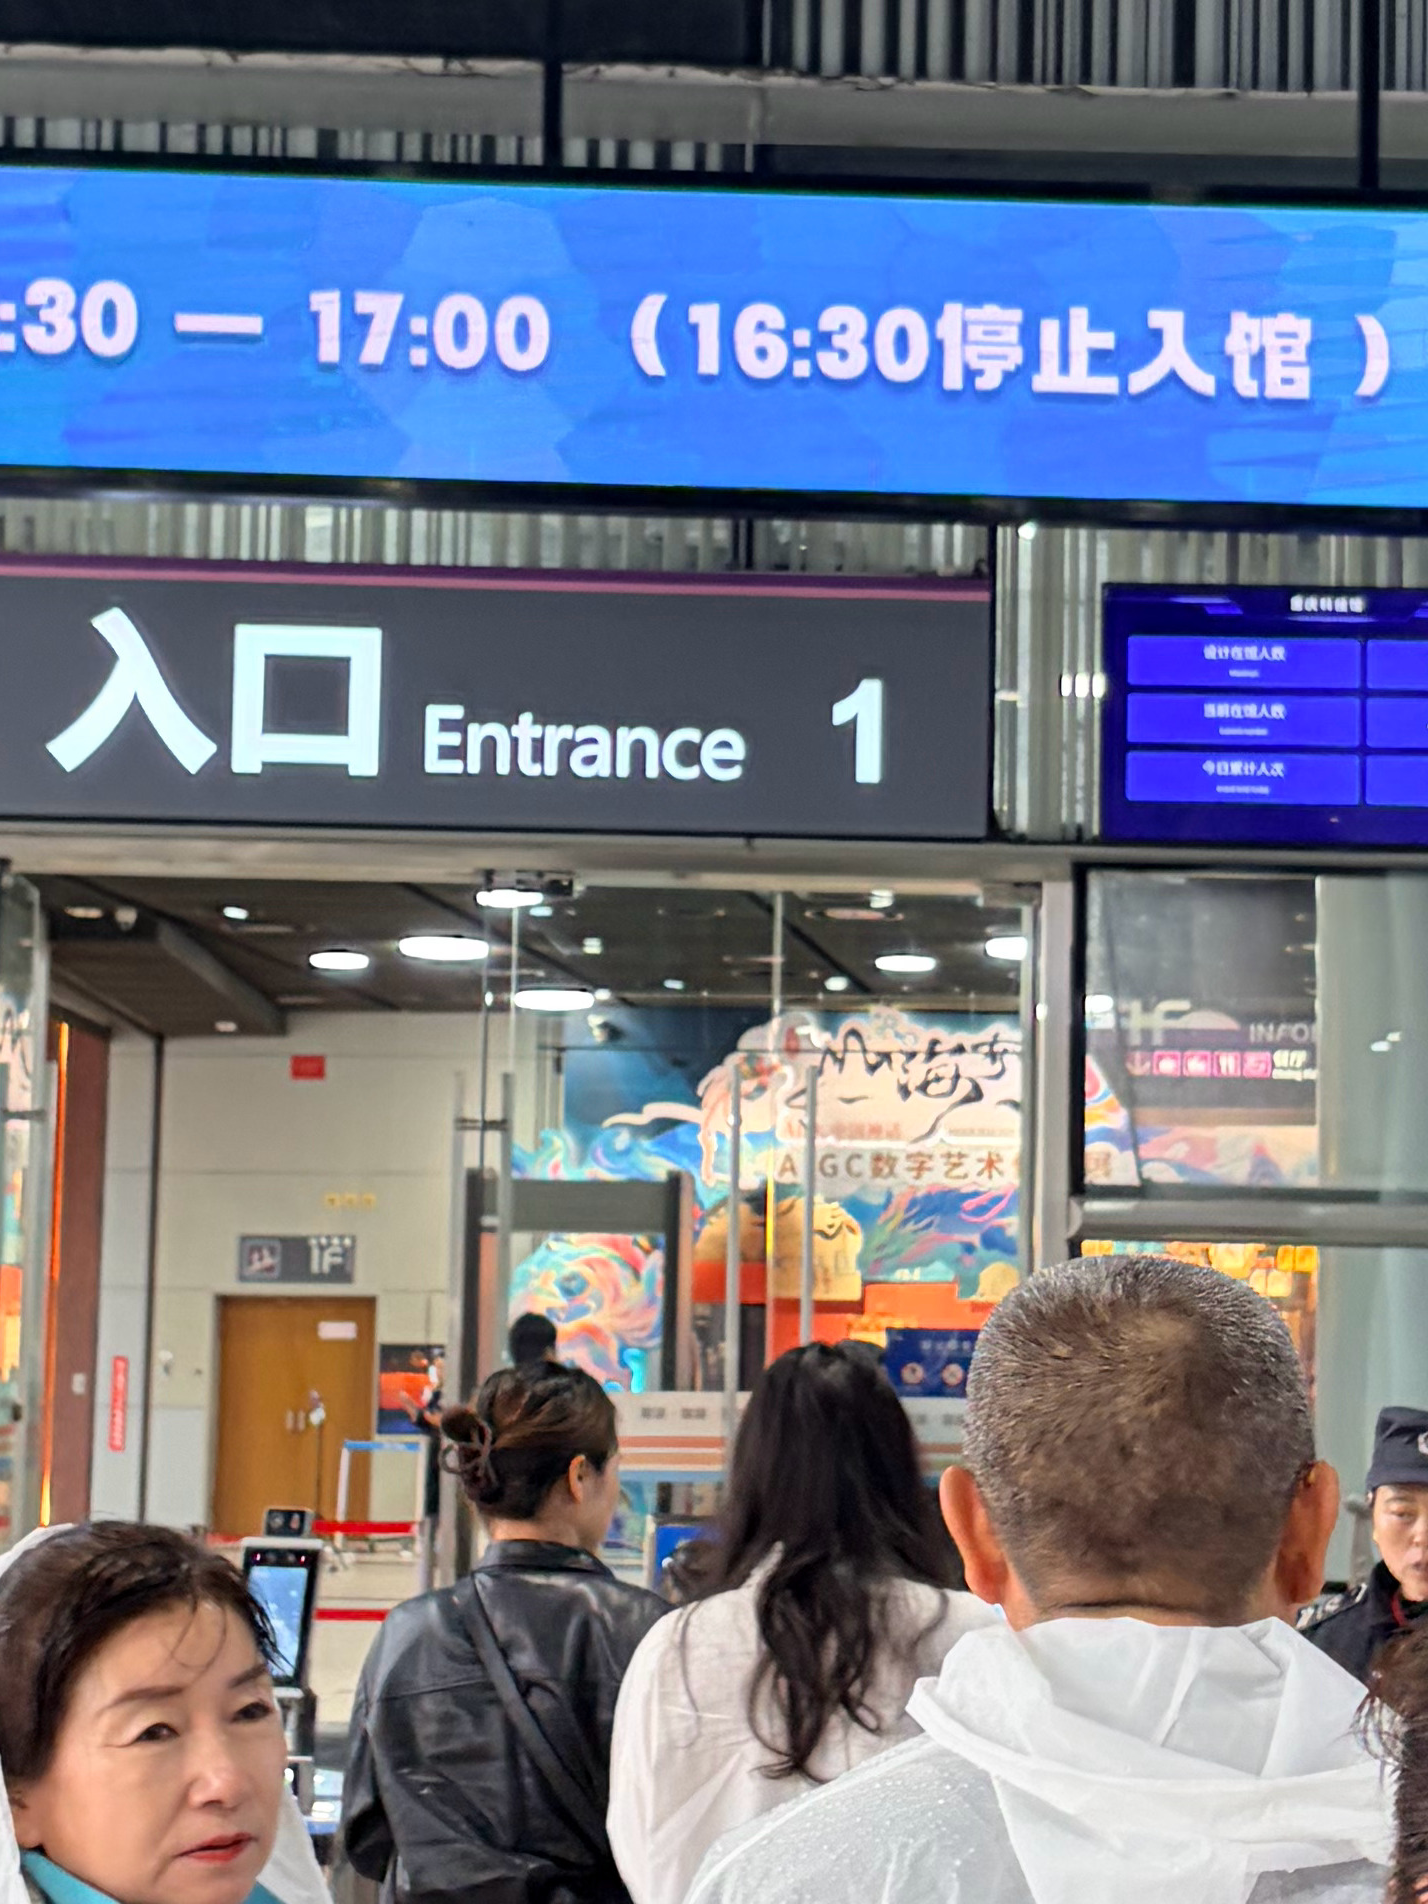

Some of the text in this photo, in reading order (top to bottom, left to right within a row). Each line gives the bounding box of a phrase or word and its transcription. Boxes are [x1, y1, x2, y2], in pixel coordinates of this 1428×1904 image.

[309, 290, 551, 372] 17:00
[45, 607, 886, 785] 入口 Entrance 1
[1248, 1021, 1317, 1044] INFO
